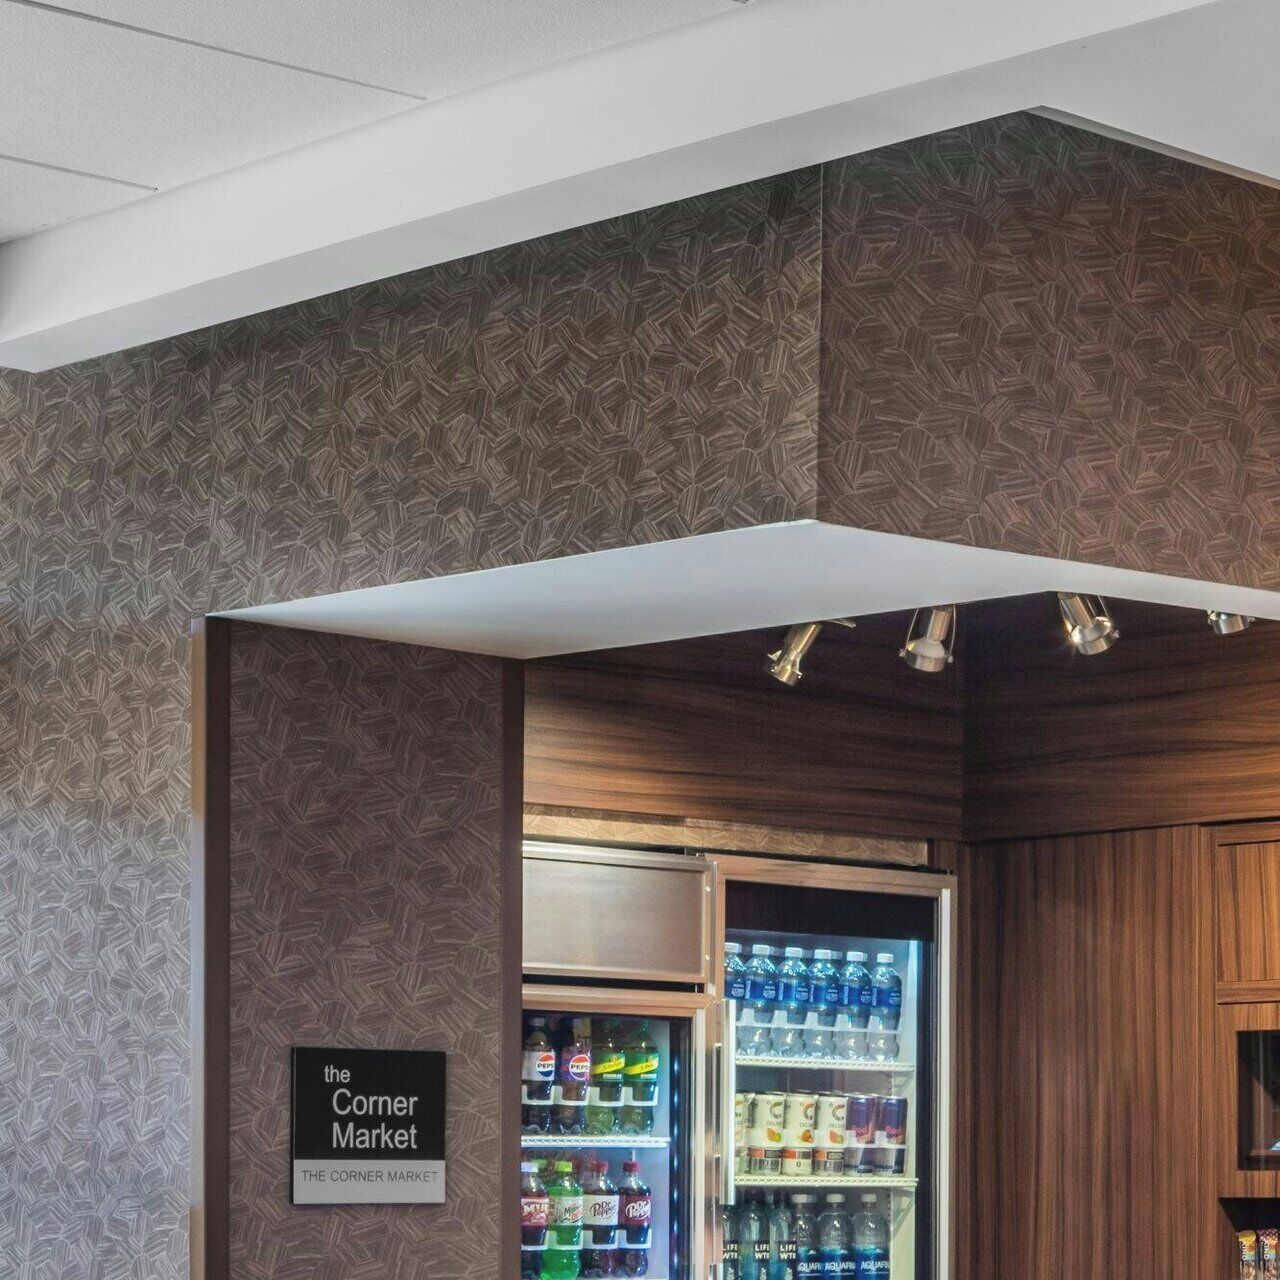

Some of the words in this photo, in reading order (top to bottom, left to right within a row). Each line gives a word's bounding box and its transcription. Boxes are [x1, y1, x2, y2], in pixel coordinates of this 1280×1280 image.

[324, 1065, 351, 1083] the
[332, 1088, 418, 1116] Corner
[332, 1122, 418, 1149] Market
[301, 1170, 326, 1182] THE
[330, 1170, 384, 1182] CORNER
[387, 1170, 439, 1183] MARKET
[797, 1262, 821, 1272] AQUAFI
[825, 1261, 856, 1272] AQUAFIN
[861, 1260, 890, 1271] AQUAFI
